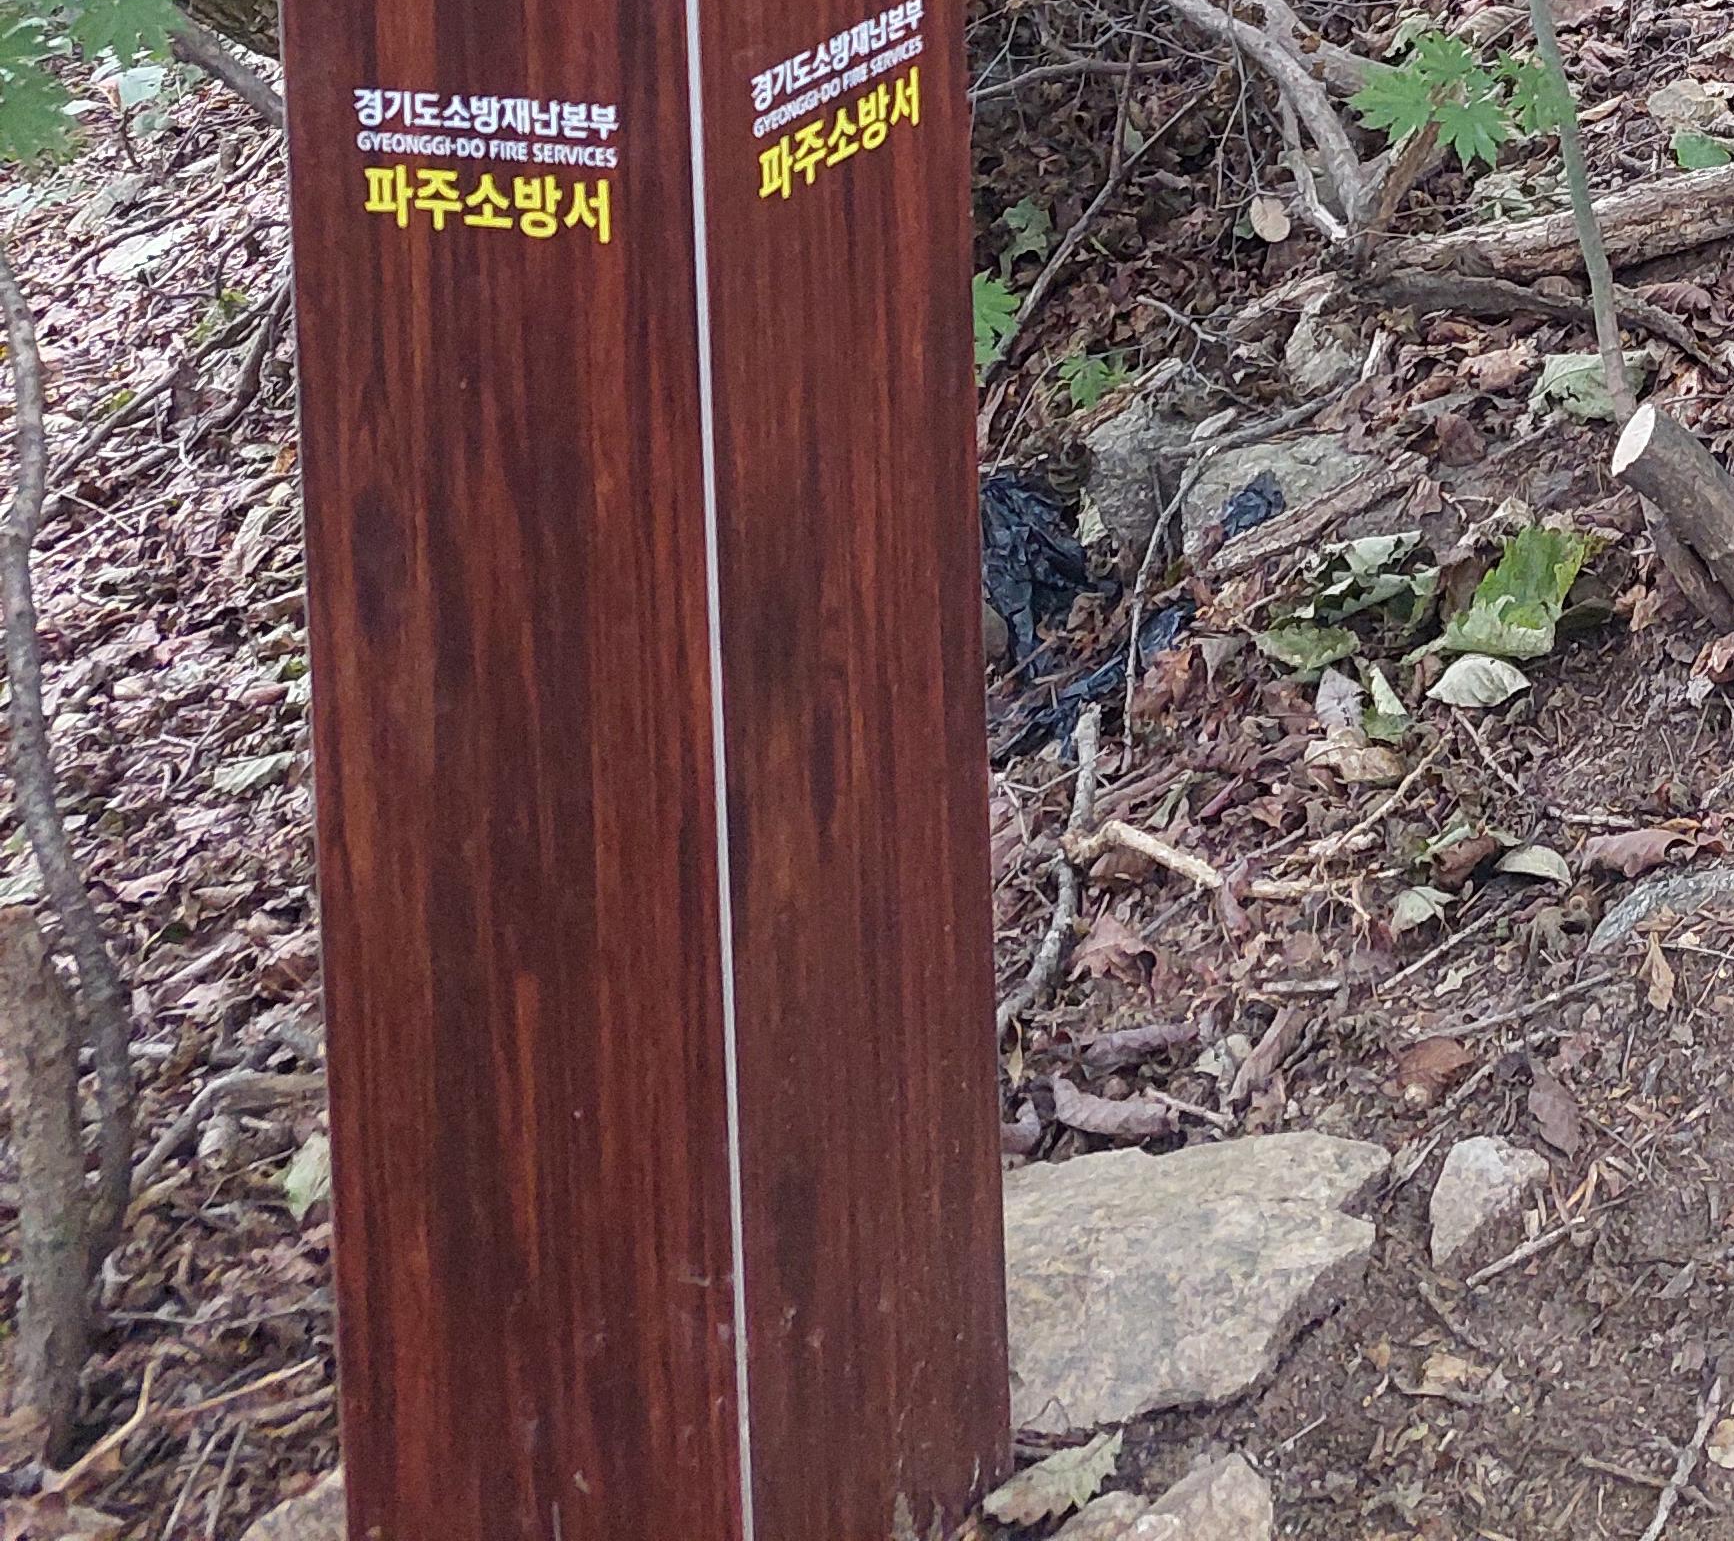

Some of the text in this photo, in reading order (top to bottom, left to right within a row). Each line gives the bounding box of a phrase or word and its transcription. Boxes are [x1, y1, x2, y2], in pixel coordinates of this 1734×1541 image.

[842, 62, 868, 92] FIRE
[869, 34, 923, 77] SERVICES
[353, 88, 620, 140] 경기도소방재난본부
[758, 65, 919, 199] 파주소방서
[356, 130, 618, 168] GYEONGGI-DO FIRE SERVICES
[364, 164, 612, 244] 파주소방서
